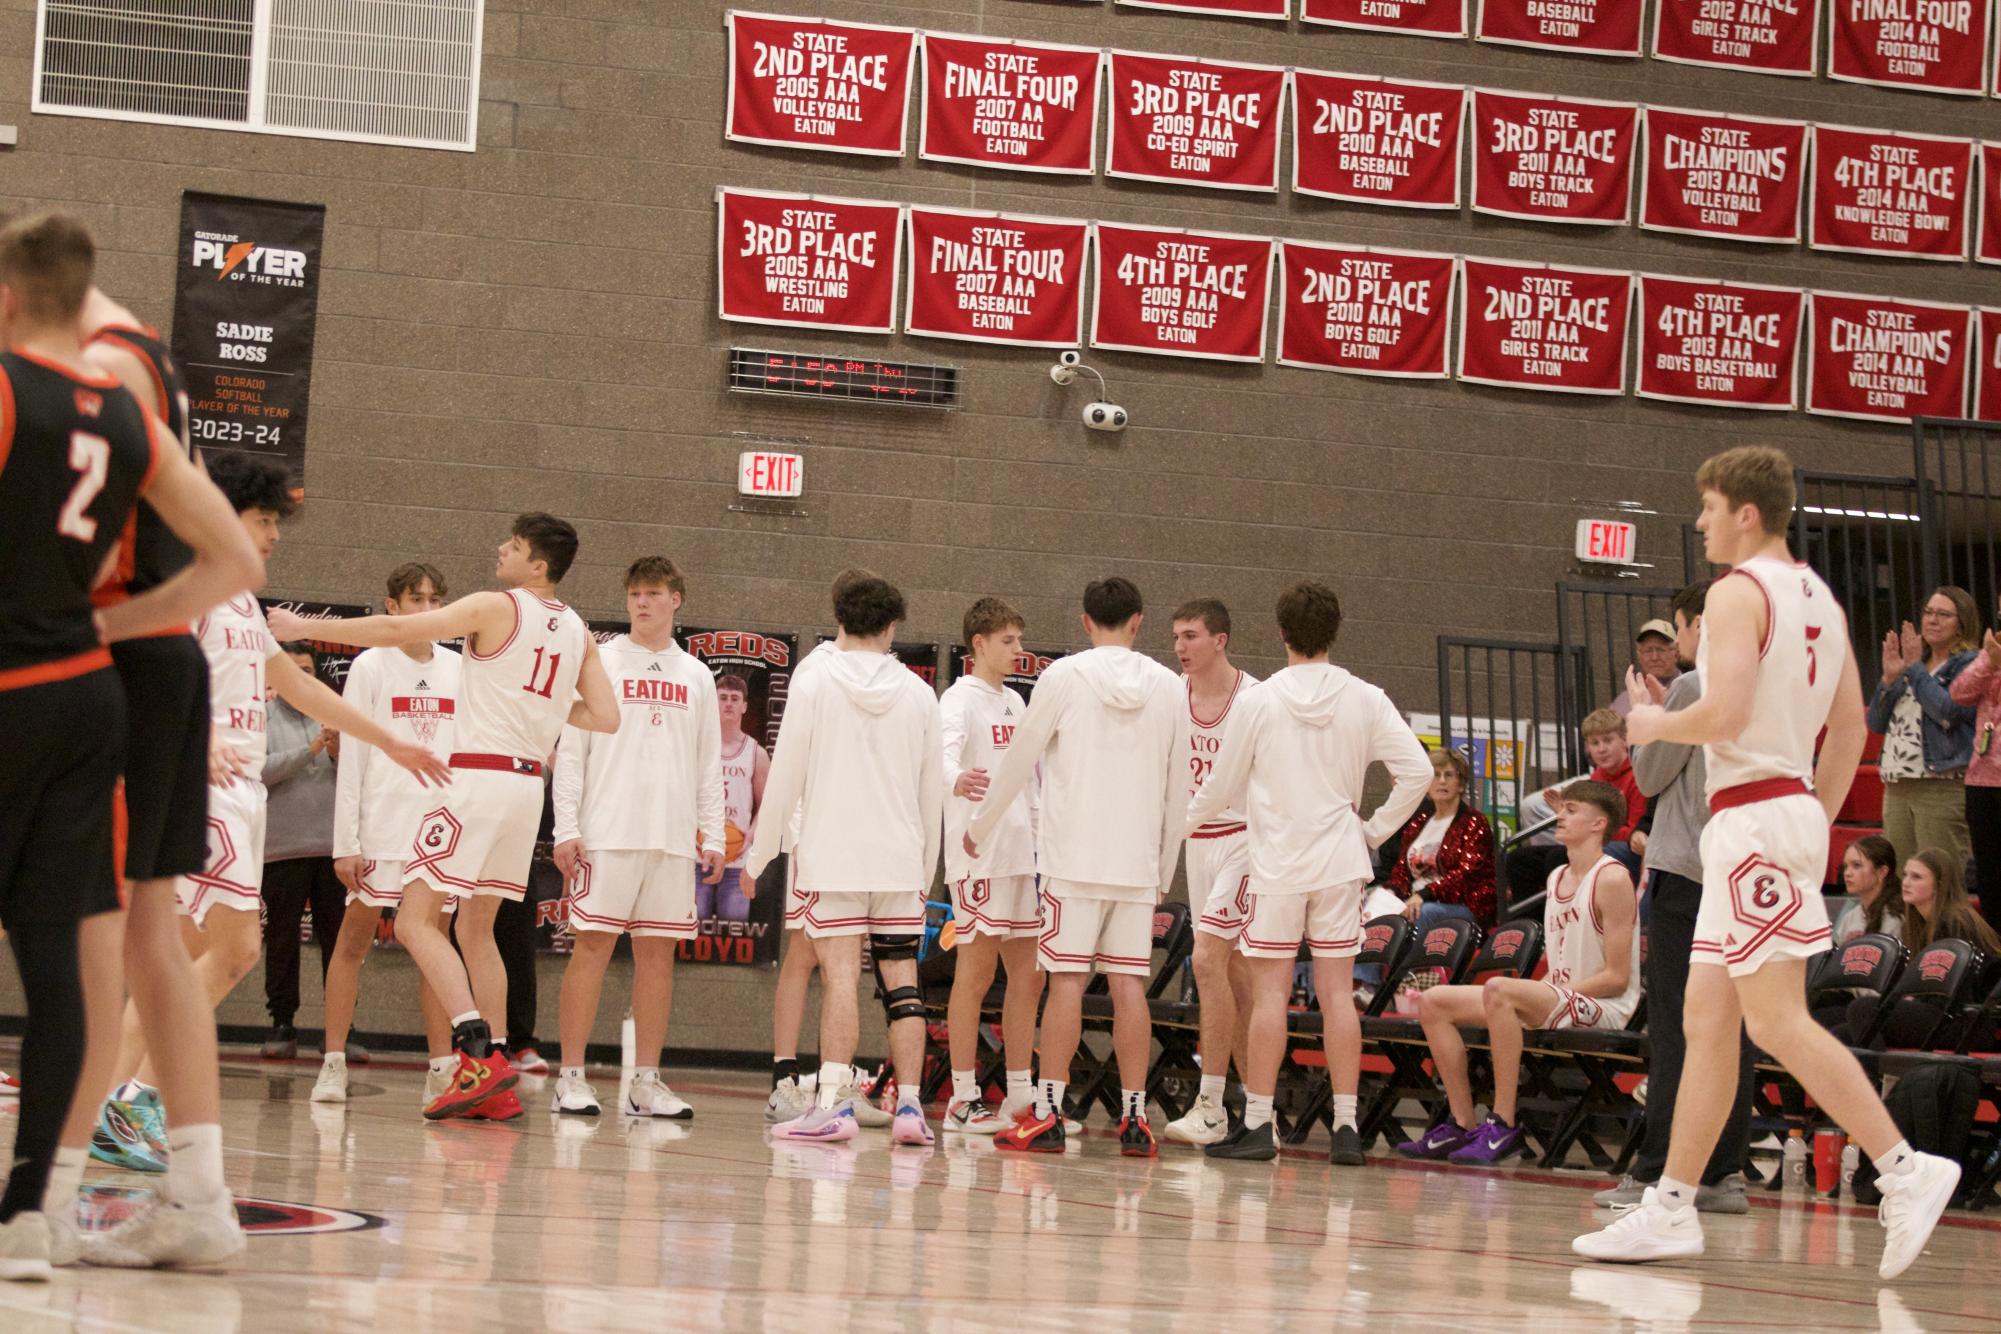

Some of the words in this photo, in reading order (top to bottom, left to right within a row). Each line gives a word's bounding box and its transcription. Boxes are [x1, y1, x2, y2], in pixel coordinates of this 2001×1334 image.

[1361, 1, 1400, 18] EATON
[1527, 1, 1595, 22] BASEBALL
[1700, 0, 1734, 21] 2012
[1740, 4, 1770, 25] AAA
[1852, 0, 1911, 22] FINAL
[1917, 0, 1971, 34] FOUR
[1540, 20, 1579, 37] EATON
[1692, 20, 1729, 38] GIRLS
[1734, 25, 1777, 44] TRACK
[1880, 22, 1914, 41] 2014
[1919, 25, 1939, 44] AA
[793, 32, 848, 52] STATE
[1713, 40, 1750, 57] EATON
[1877, 40, 1940, 64] FOOTBALL
[754, 42, 804, 77] 2ND
[810, 45, 888, 91] PLACE
[986, 53, 1038, 73] STATE
[1889, 59, 1925, 76] EATON
[776, 77, 815, 98] 2005
[824, 80, 859, 103] AAA
[945, 62, 1013, 98] FINAL
[1017, 75, 1078, 111] FOUR
[1170, 70, 1222, 90] STATE
[774, 97, 862, 121] VOLLEYBALL
[976, 99, 1016, 119] 2007
[1022, 103, 1043, 122] AA
[1131, 80, 1178, 115] 3RD
[1186, 91, 1260, 129] PLACE
[1352, 90, 1404, 110] STATE
[795, 118, 835, 135] EATON
[974, 118, 1044, 140] FOOTBALL
[1153, 115, 1194, 136] 2009
[1200, 118, 1233, 140] AAA
[1313, 99, 1362, 134] 2ND
[1367, 110, 1442, 148] PLACE
[1529, 109, 1578, 128] STATE
[987, 138, 1027, 155] EATON
[1148, 134, 1189, 152] CO-ED
[1194, 139, 1238, 158] SPIRIT
[1339, 134, 1375, 154] 2010
[1380, 136, 1413, 158] AAA
[1492, 118, 1538, 152] 3RD
[1545, 129, 1616, 164] PLACE
[1701, 127, 1750, 147] STATE
[1171, 154, 1210, 172] EATON
[1340, 154, 1409, 176] BASEBALL
[1519, 153, 1548, 172] 2011
[1554, 154, 1585, 176] AAA
[1664, 134, 1786, 182] CHAMPIONS
[1870, 145, 1918, 164] STATE
[1354, 174, 1392, 190] EATON
[1509, 172, 1544, 189] BOYS
[1550, 175, 1593, 193] TRACK
[1688, 171, 1722, 190] 2013
[1726, 173, 1758, 194] AAA
[1835, 156, 1879, 187] 4TH
[1886, 165, 1954, 200] PLACE
[1531, 191, 1568, 208] EATON
[1682, 189, 1761, 212] VOLLEYBALL
[1857, 188, 1892, 208] 2014
[1897, 190, 1928, 212] AAA
[782, 210, 836, 230] STATE
[1702, 209, 1738, 226] EATON
[1836, 206, 1910, 227] KNOWLEDGE
[194, 231, 239, 242] GATORADE
[741, 219, 792, 256] 3RD
[799, 231, 876, 268] PLACE
[972, 227, 1025, 247] STATE
[1872, 226, 1908, 243] EATON
[931, 236, 1000, 273] FINAL
[1004, 249, 1064, 285] FOUR
[1157, 242, 1210, 262] STATE
[765, 256, 808, 277] 2005
[814, 258, 848, 280] AAA
[1118, 254, 1165, 285] 4TH
[1174, 263, 1247, 299] PLACE
[1341, 259, 1392, 279] STATE
[230, 272, 246, 281] OF
[251, 274, 271, 285] THE
[276, 277, 304, 288] YEAR
[766, 276, 848, 298] WRESTLING
[956, 274, 997, 293] 2007
[1002, 276, 1035, 297] AAA
[1522, 277, 1572, 296] STATE
[1142, 287, 1181, 307] 2009
[1186, 290, 1218, 311] AAA
[1302, 268, 1350, 303] 2ND
[1358, 279, 1430, 316] PLACE
[1695, 293, 1744, 312] STATE
[784, 296, 824, 313] EATON
[959, 294, 1031, 314] BASEBALL
[1327, 302, 1363, 322] 2010
[1368, 304, 1401, 326] AAA
[1484, 286, 1532, 321] 2ND
[1538, 296, 1609, 332] PLACE
[973, 313, 1013, 330] EATON
[1142, 306, 1178, 324] BOYS
[1183, 311, 1216, 328] GOLF
[1658, 305, 1703, 336] 4TH
[1710, 313, 1780, 347] PLACE
[1867, 310, 1915, 330] STATE
[216, 322, 273, 343] SADIE
[1158, 326, 1196, 343] EATON
[1326, 324, 1360, 341] BOYS
[1368, 328, 1400, 344] GOLF
[1511, 320, 1542, 339] 2011
[1547, 322, 1578, 343] AAA
[1831, 317, 1951, 366] CHAMPIONS
[218, 343, 267, 363] ROSS
[1341, 343, 1380, 360] EATON
[1501, 340, 1538, 357] GIRLS
[1544, 344, 1588, 362] TRACK
[1682, 337, 1716, 356] 2013
[1721, 338, 1752, 360] AAA
[1524, 360, 1561, 376] EATON
[1657, 354, 1690, 372] BOYS
[1695, 358, 1776, 380] BASKETBALL
[1854, 353, 1888, 373] 2014
[1893, 356, 1924, 377] AAA
[215, 375, 266, 390] COLORADO
[1697, 375, 1733, 392] EATON
[1849, 372, 1927, 394] VOLLEYBALL
[215, 388, 263, 403] SOFTBALL
[1868, 391, 1904, 408] EATON
[190, 400, 224, 412] LAYER
[226, 404, 240, 415] OF
[243, 404, 260, 416] THE
[263, 407, 290, 418] YEAR
[191, 418, 281, 446] 2023-24
[753, 455, 796, 492] EXIT
[57, 430, 111, 543] 2
[1590, 523, 1629, 559] EXIT
[224, 628, 265, 652] EATO
[685, 631, 789, 667] REDS
[522, 646, 561, 699] 11
[744, 659, 767, 669] SCHOOL
[623, 679, 688, 704] EATON
[392, 711, 455, 721] BASKETBALL
[409, 698, 440, 712] EATON
[229, 707, 266, 733] RED
[701, 914, 768, 937] drew
